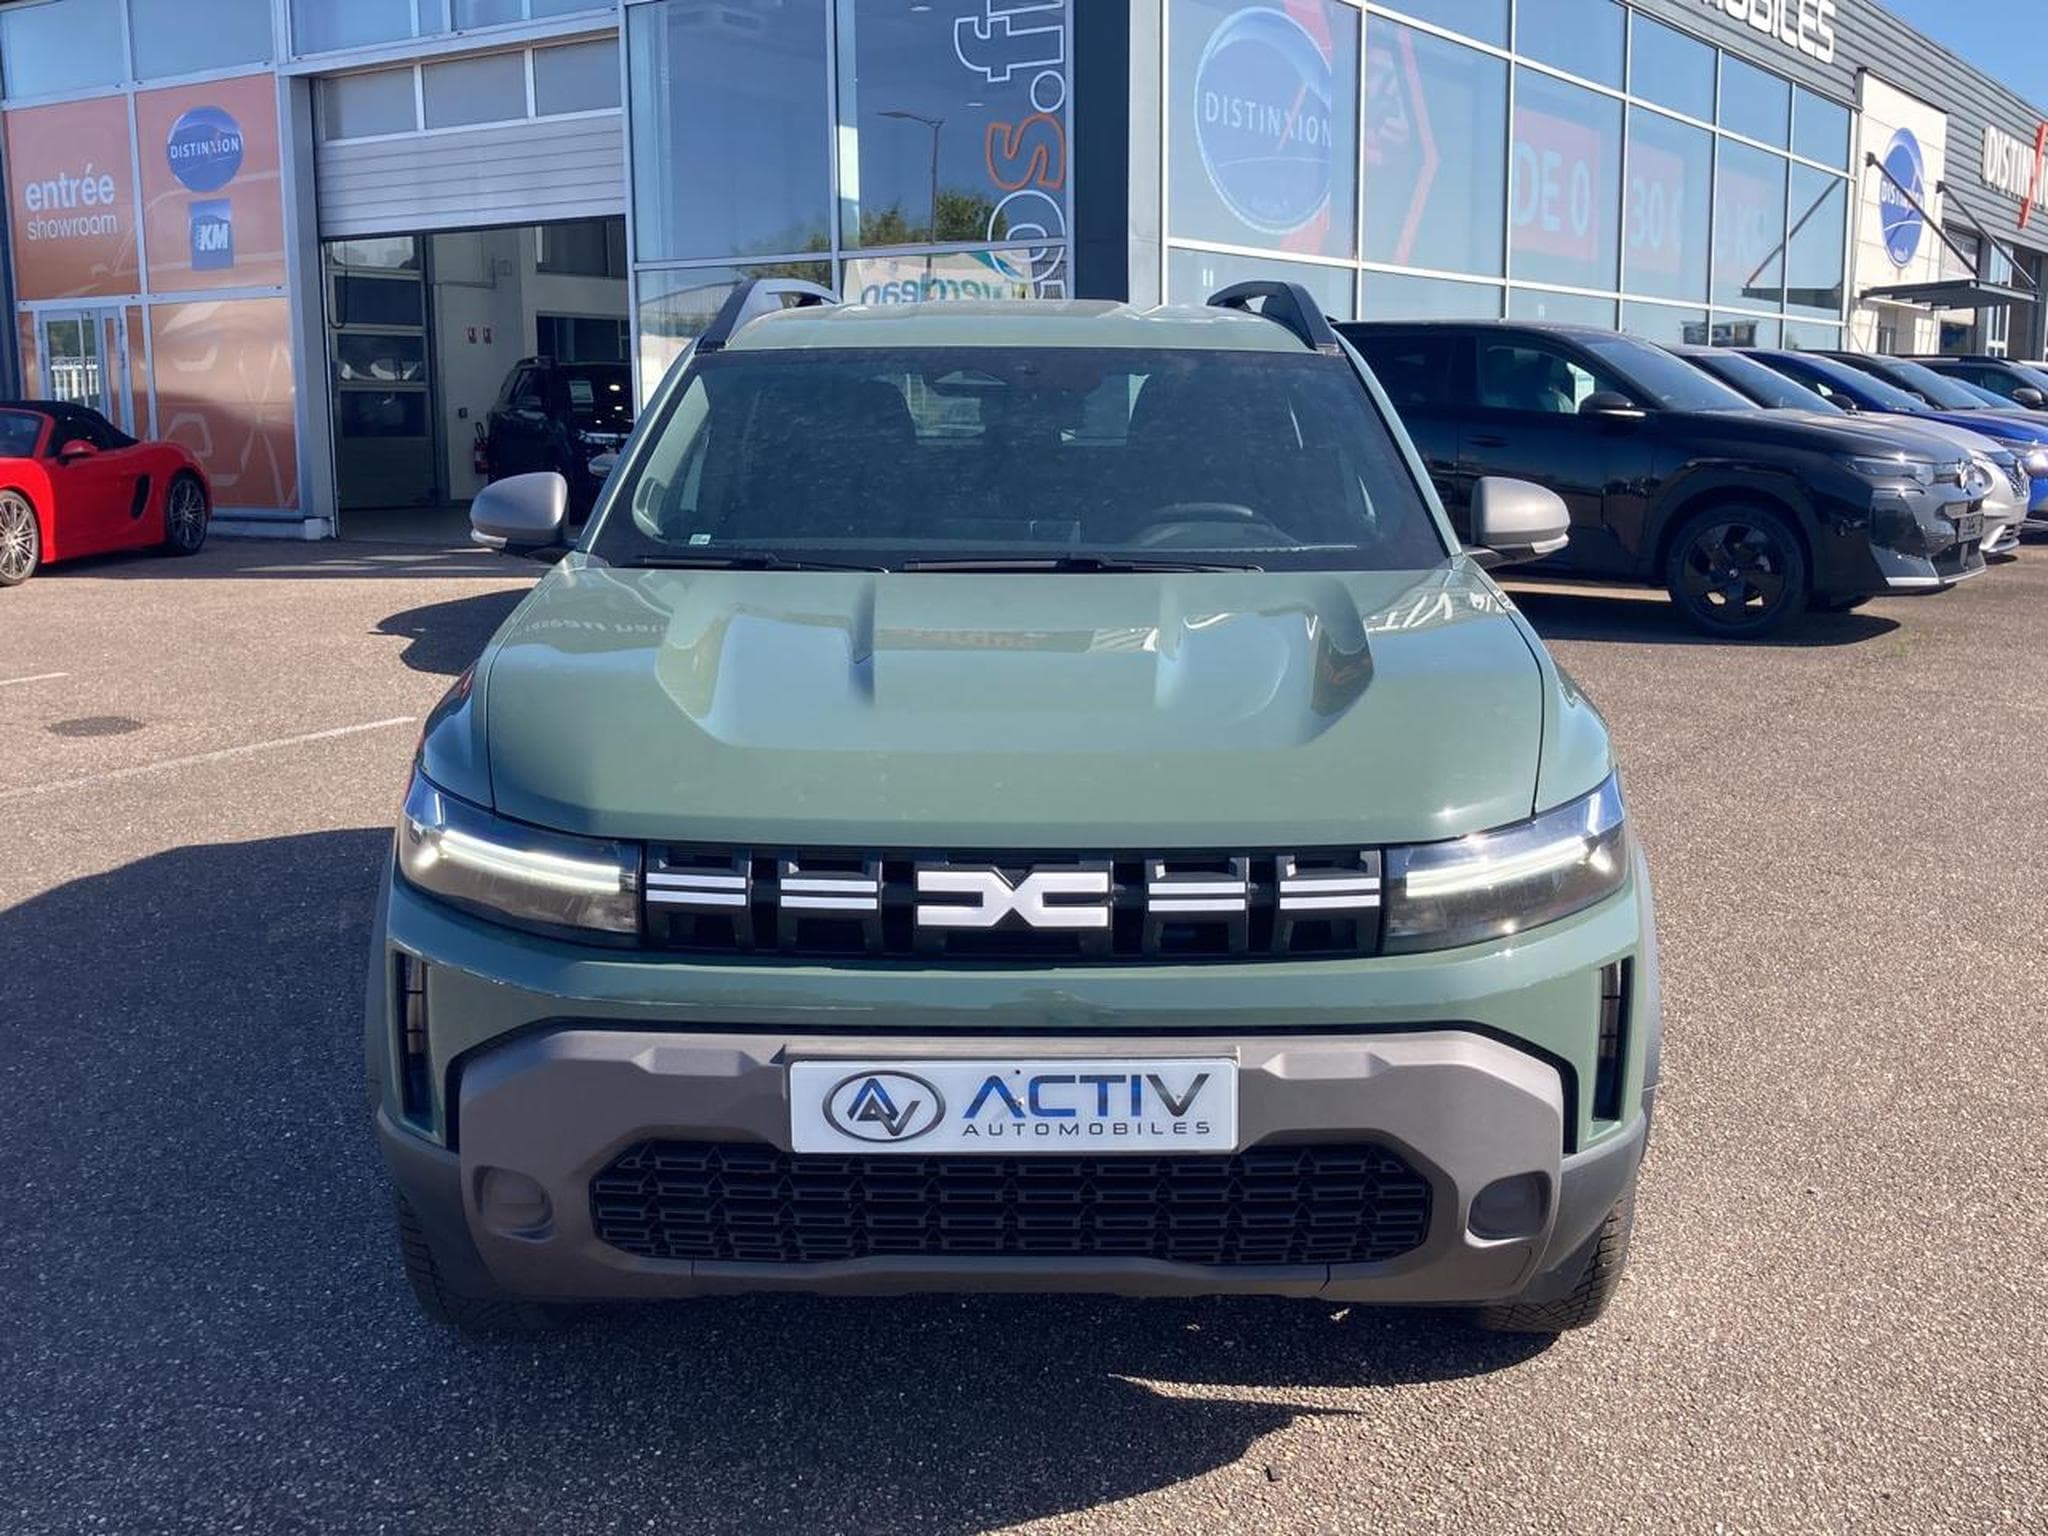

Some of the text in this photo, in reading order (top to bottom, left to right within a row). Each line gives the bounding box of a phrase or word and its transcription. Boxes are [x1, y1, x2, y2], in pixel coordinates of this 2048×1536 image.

[25, 163, 116, 211] entrée
[27, 212, 118, 241] showroom
[962, 1073, 1211, 1119] ACTIV
[962, 1121, 1211, 1137] AUTOMOBILES
